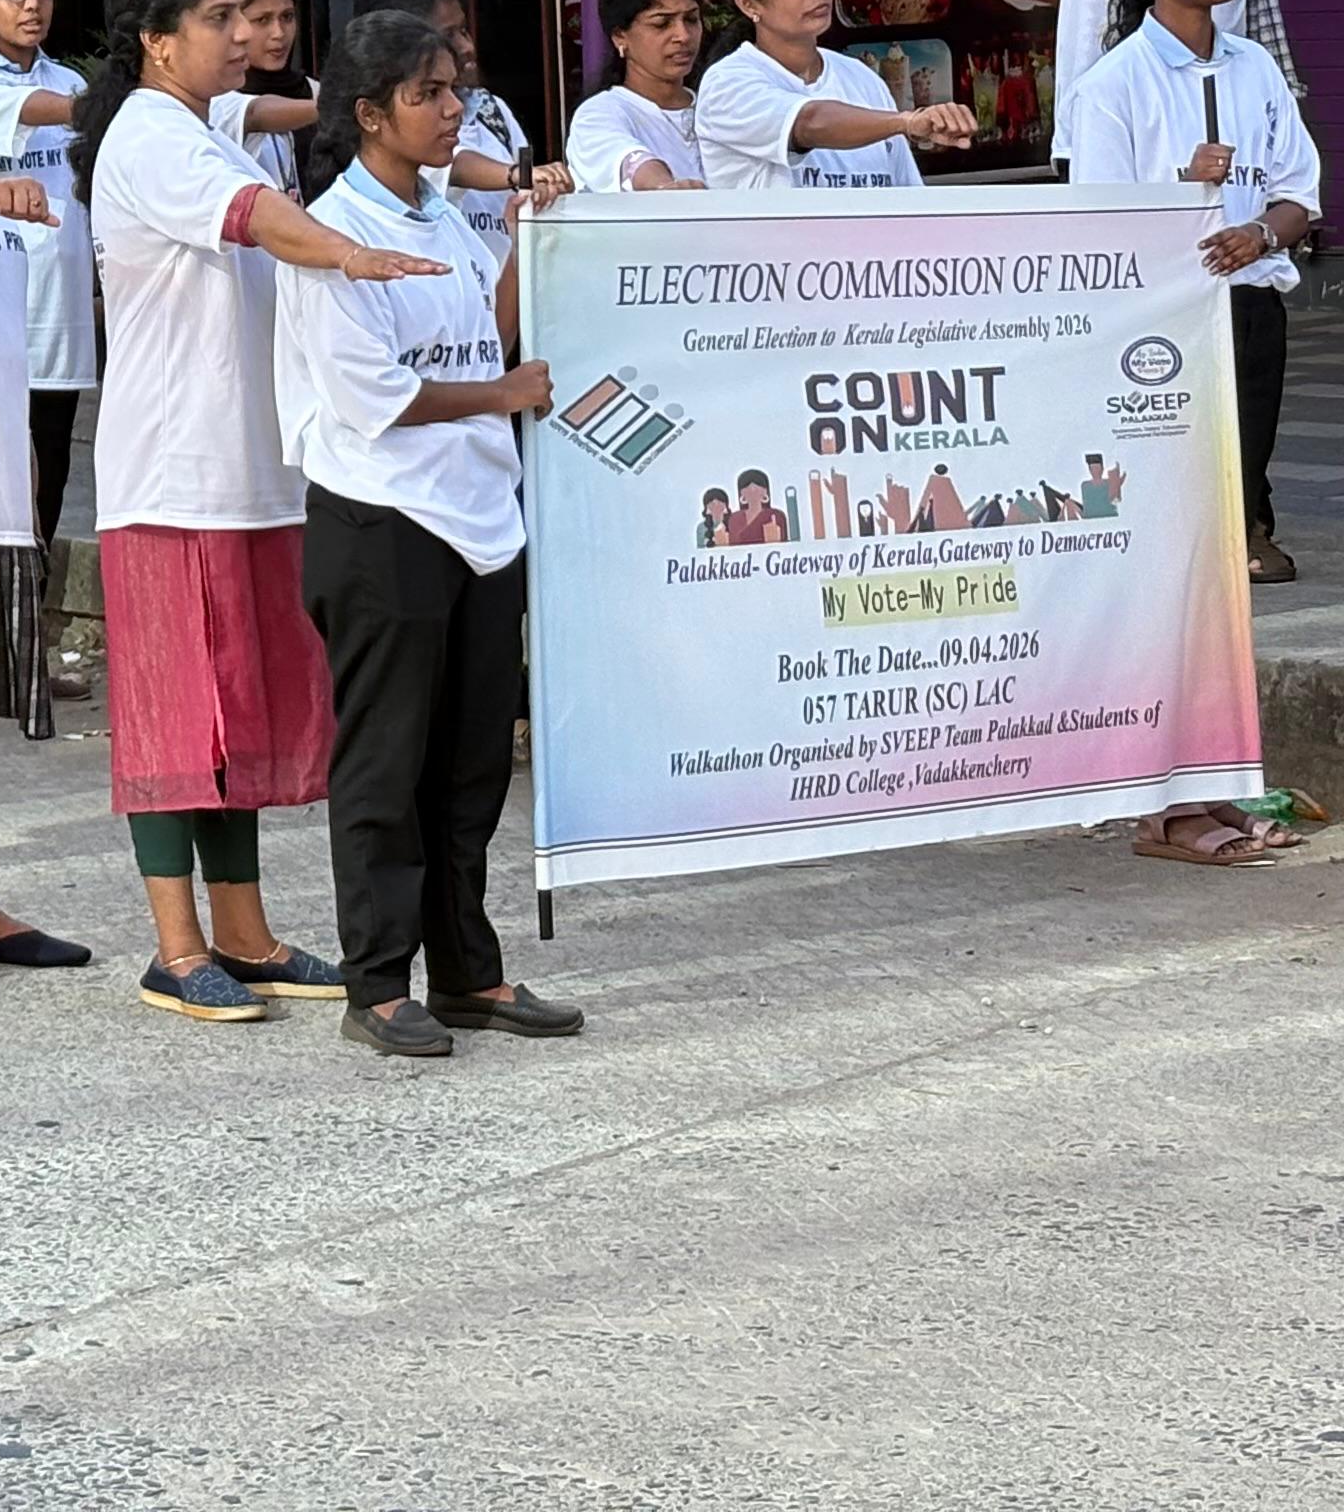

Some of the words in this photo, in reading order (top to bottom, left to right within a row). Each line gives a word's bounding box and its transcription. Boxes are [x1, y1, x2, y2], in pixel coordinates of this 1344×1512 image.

[18, 150, 45, 170] VOTE
[46, 148, 62, 167] MY
[615, 261, 791, 306] ELECTION
[797, 255, 1006, 302] COMMISSION
[1012, 252, 1053, 294] OF
[1058, 250, 1145, 293] INDIA
[683, 327, 750, 353] General
[752, 324, 818, 351] Election
[820, 328, 837, 348] to
[843, 321, 894, 348] Kerala
[897, 318, 978, 350] Legislative
[979, 315, 1051, 343] Assembly
[1055, 313, 1093, 338] 2026
[805, 366, 1006, 427] COUNT
[809, 414, 890, 456] ON
[894, 426, 1011, 452] KERALA
[666, 552, 760, 585] Palakkad-
[765, 550, 844, 578] Gateway
[848, 544, 871, 577] of
[1017, 535, 1035, 556] to
[1040, 529, 1132, 555] Democracy
[821, 586, 847, 622] My
[956, 572, 1018, 608] Pride
[777, 650, 829, 683] Book
[833, 647, 872, 678] The
[802, 694, 838, 726] 057
[843, 685, 920, 721] TARUR
[925, 681, 969, 718] (SC)
[973, 675, 1017, 708] LAC
[669, 747, 764, 778] Walkathon
[769, 735, 855, 771] Organised
[858, 736, 878, 763] by
[880, 725, 941, 756] SVEEP
[944, 723, 983, 748] Team
[986, 712, 1055, 743] Palakkad
[1143, 699, 1164, 729] of
[790, 773, 841, 802] IHRD
[845, 767, 906, 798] College
